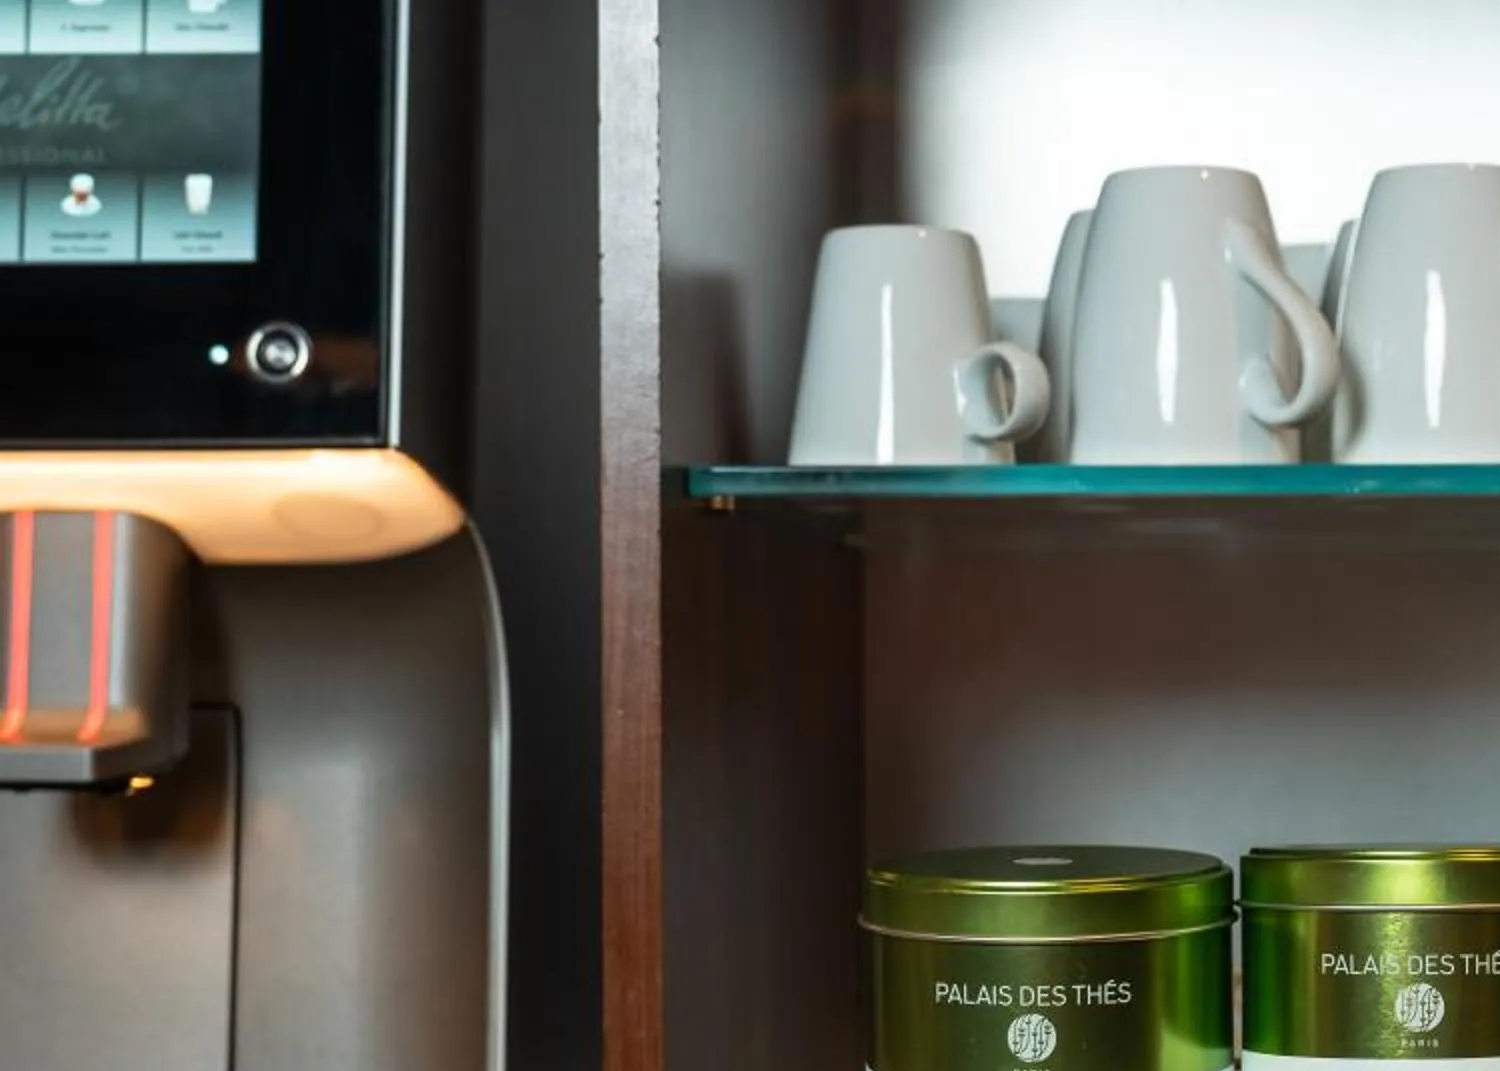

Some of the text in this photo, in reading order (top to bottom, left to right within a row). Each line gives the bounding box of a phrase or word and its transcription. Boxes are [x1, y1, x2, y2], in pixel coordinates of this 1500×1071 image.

[1321, 953, 1400, 975] PALAIS
[1408, 954, 1454, 975] DES
[935, 979, 1132, 1007] PALAIS DES THÉS
[1401, 1039, 1439, 1048] PARIS
